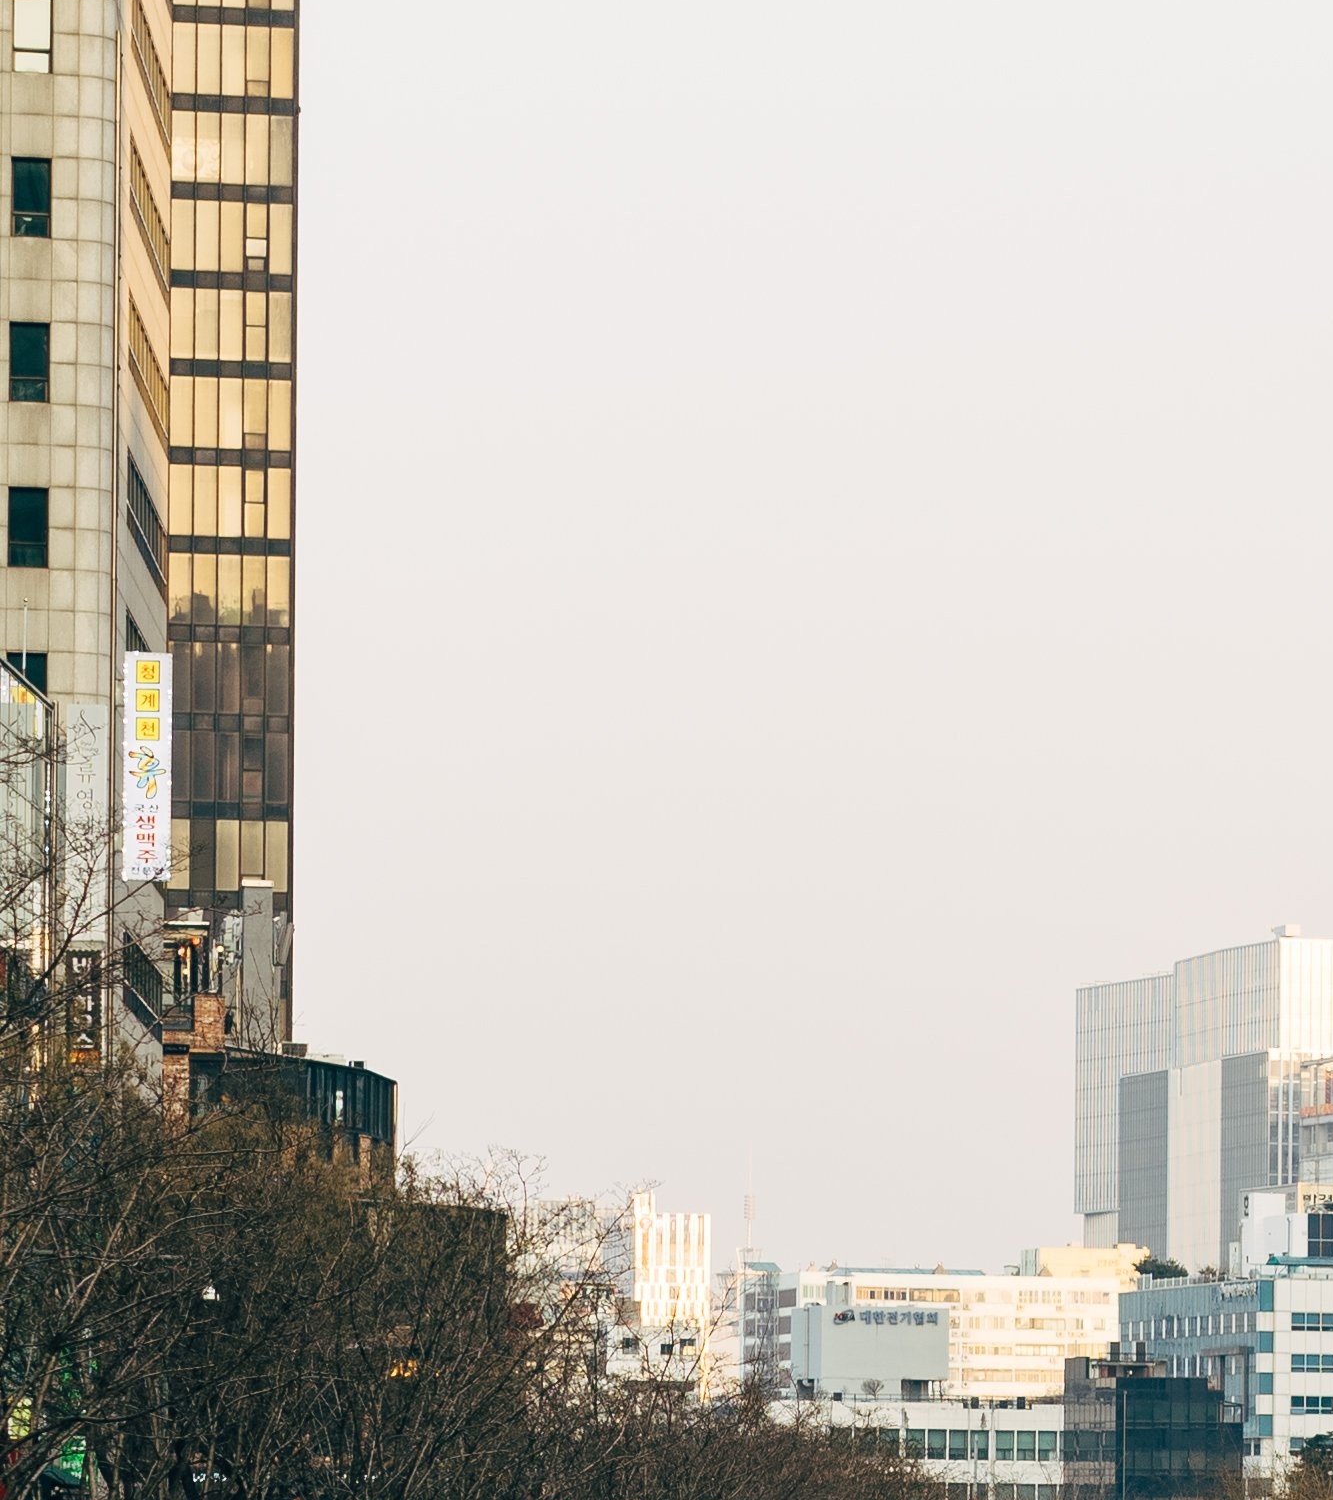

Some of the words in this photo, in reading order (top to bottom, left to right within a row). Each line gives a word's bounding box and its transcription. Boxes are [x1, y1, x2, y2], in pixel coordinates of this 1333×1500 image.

[140, 662, 157, 738] 청계천
[135, 814, 158, 864] 생맥주
[859, 1309, 939, 1326] 대한전기협회
